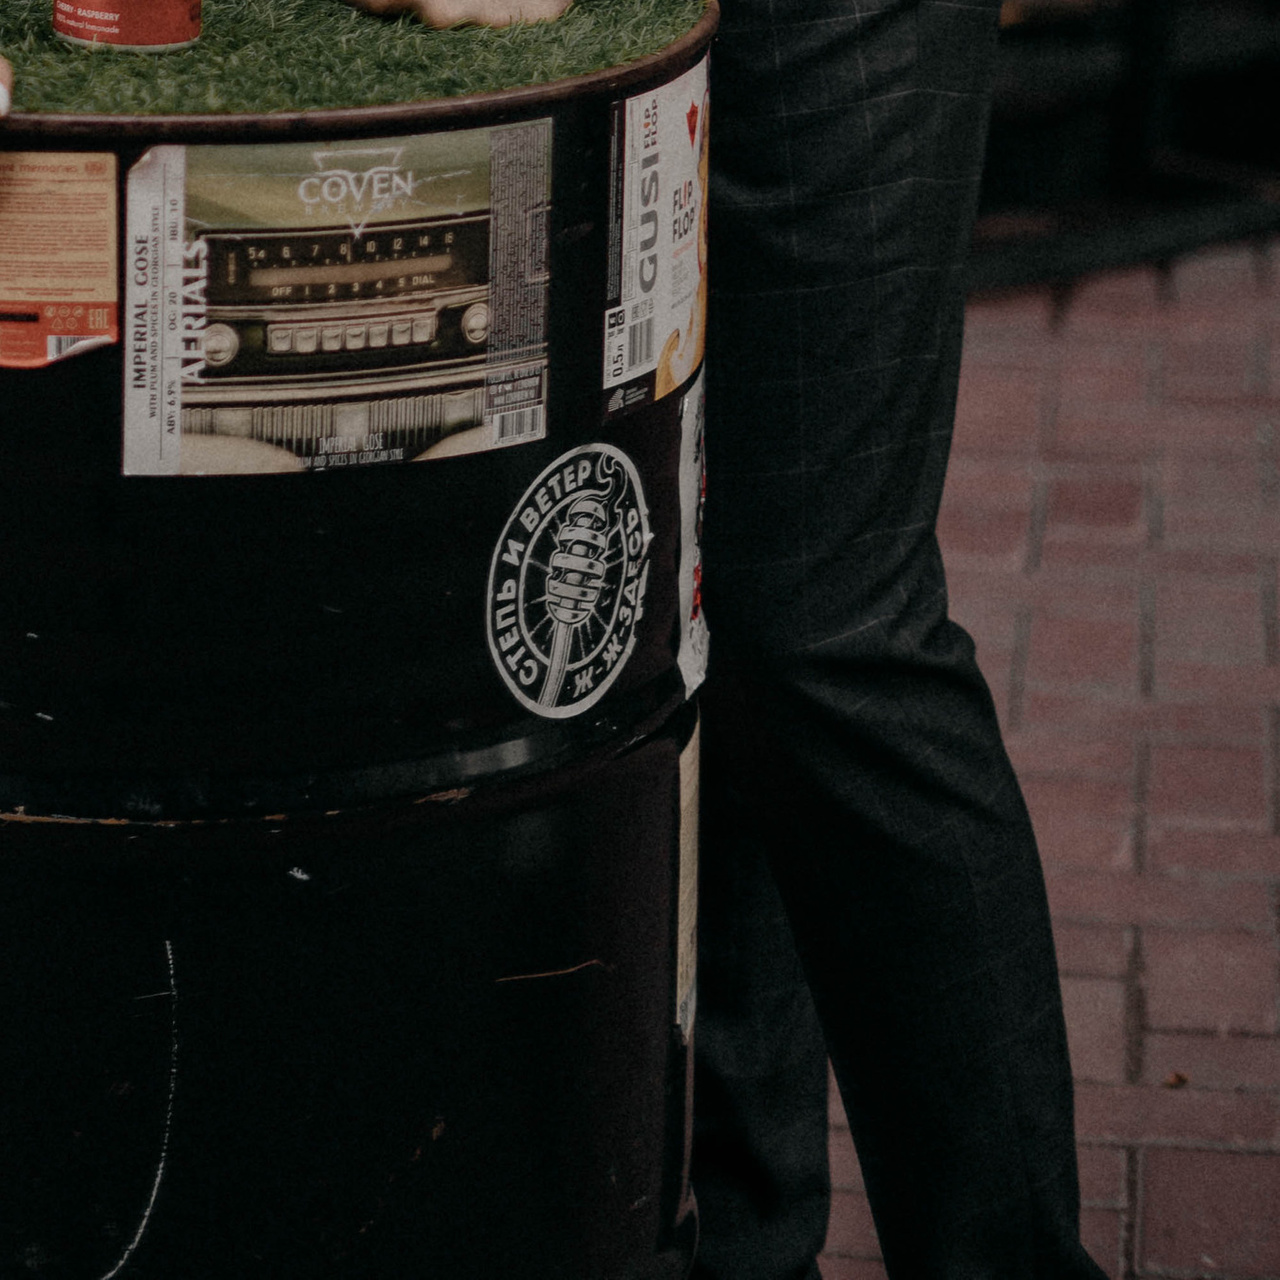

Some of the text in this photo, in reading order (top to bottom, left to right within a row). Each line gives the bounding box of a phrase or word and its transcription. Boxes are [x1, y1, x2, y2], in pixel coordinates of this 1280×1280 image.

[77, 7, 120, 22] RASPBERRY
[298, 168, 413, 203] COVEN
[672, 180, 693, 216] FLIP
[170, 199, 178, 214] 10
[639, 152, 659, 294] GUSI
[672, 207, 695, 243] FLOP
[312, 244, 319, 257] 7
[367, 241, 376, 252] 10
[393, 238, 402, 250] 12
[420, 235, 429, 246] 14
[272, 286, 292, 297] OFF
[328, 284, 336, 294] 2
[353, 283, 360, 291] 3
[376, 280, 383, 289] 4
[412, 274, 436, 286] DIAL
[133, 235, 149, 389] IMPERIAL GOSE
[149, 206, 160, 418] WITH PLUM AND SPICES IN GEORGIAN STYLE
[168, 291, 177, 330] OG: 20
[181, 240, 208, 383] AERIALS
[166, 410, 176, 434] ABV:
[313, 455, 326, 467] AND
[328, 454, 347, 466] SPICES
[349, 453, 357, 464] IN
[359, 449, 389, 463] GEORGIAN
[389, 448, 404, 460] STYLE
[319, 433, 383, 454] IMPERIAL GOSE
[496, 459, 592, 685] СТЕПЬ И ВЕТЕР
